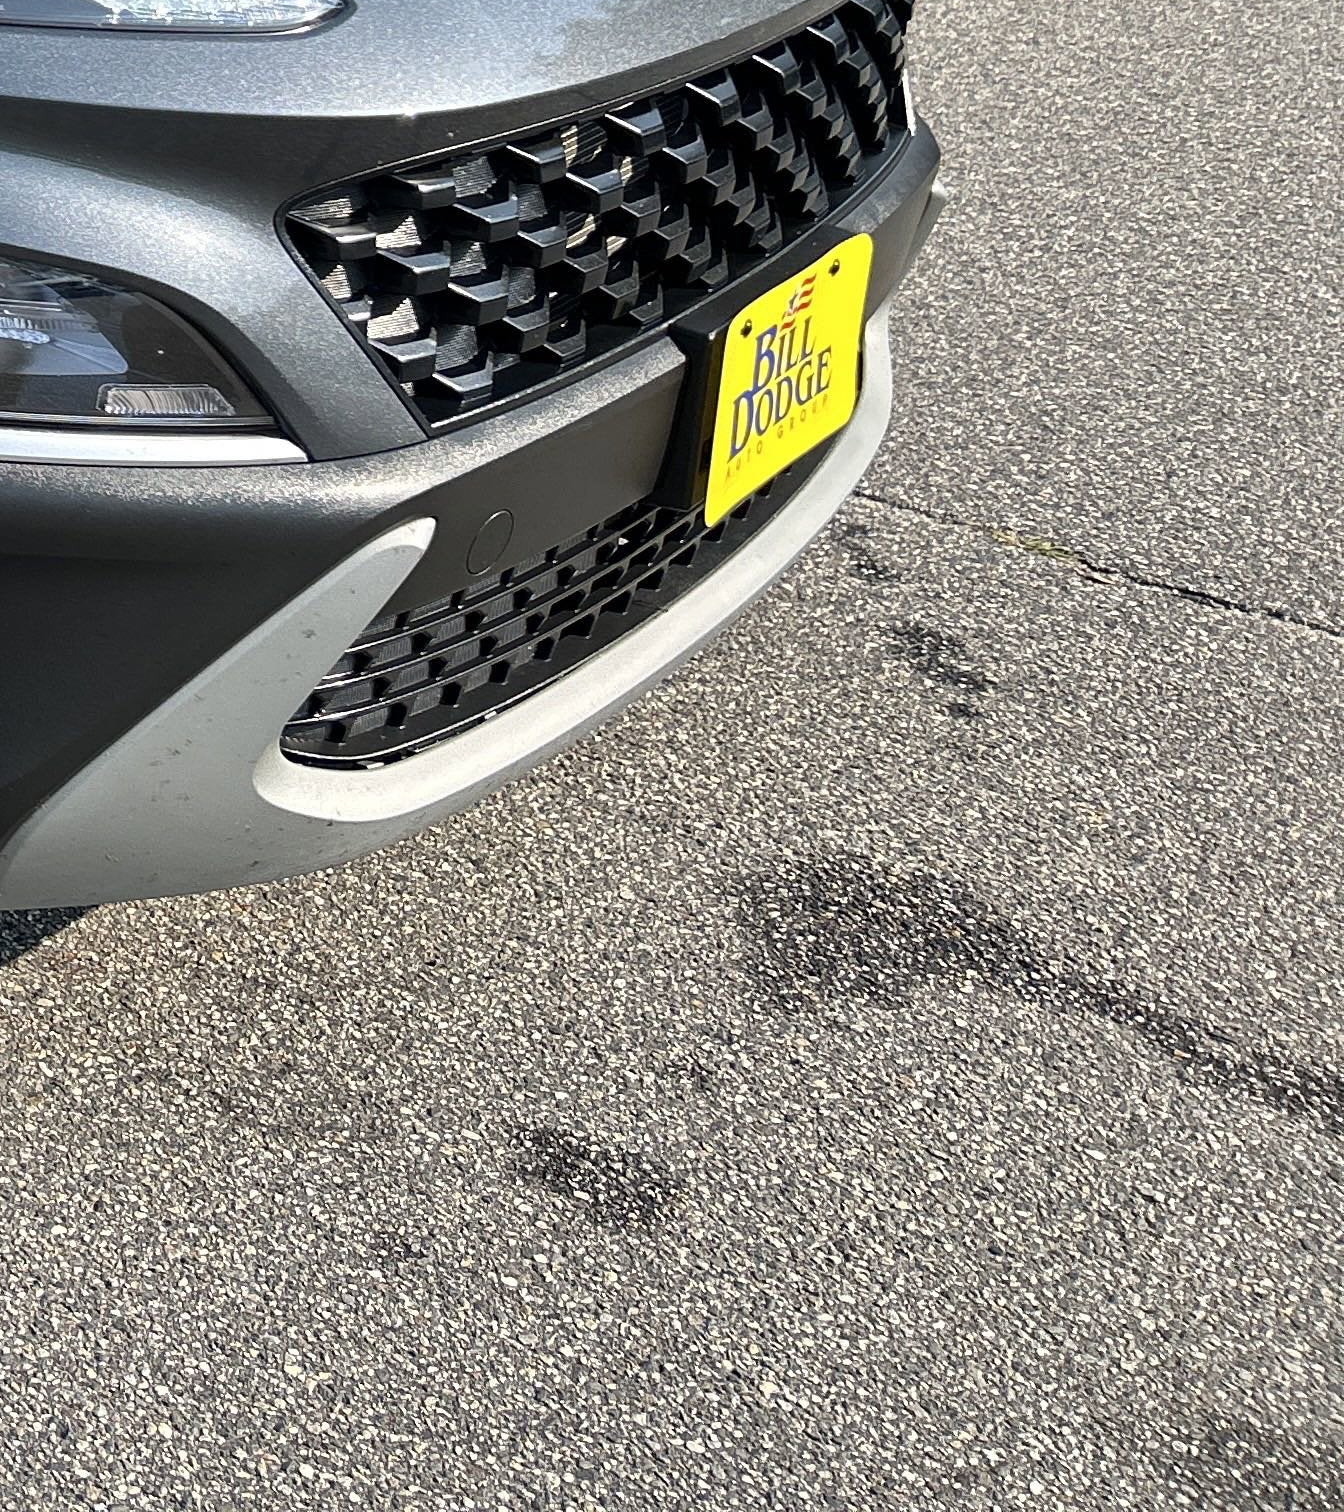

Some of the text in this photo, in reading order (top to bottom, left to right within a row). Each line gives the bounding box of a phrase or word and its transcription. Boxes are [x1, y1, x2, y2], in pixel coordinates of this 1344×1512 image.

[752, 315, 817, 393] BILL
[725, 393, 829, 482] AUTO GROUP
[727, 344, 832, 464] DODGE
